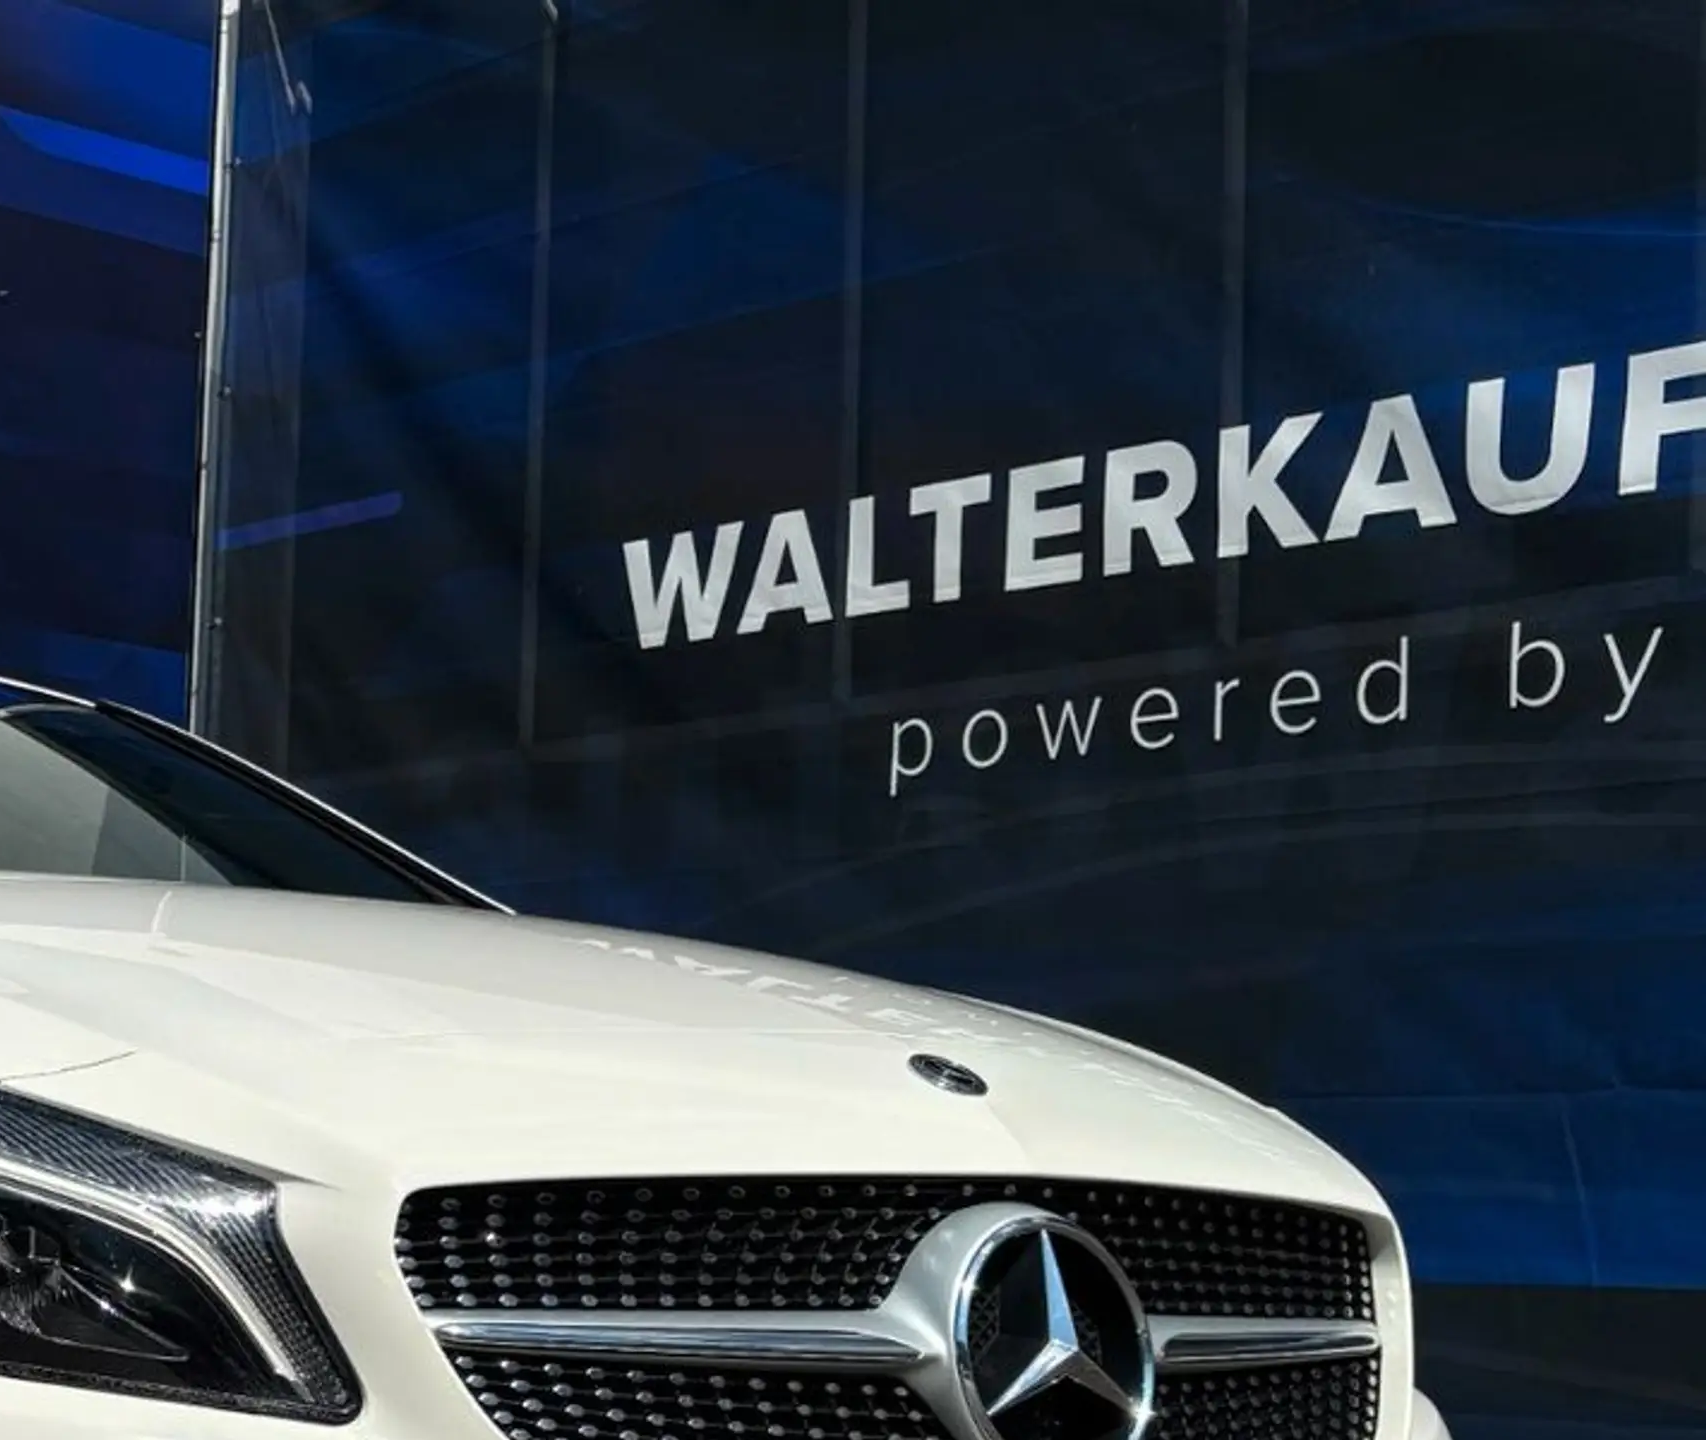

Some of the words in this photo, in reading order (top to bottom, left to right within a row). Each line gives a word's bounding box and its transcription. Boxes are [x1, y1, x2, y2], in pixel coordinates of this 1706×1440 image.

[622, 340, 1706, 650] WALTERKAUF
[889, 635, 1409, 797] powered
[1509, 620, 1663, 723] by
